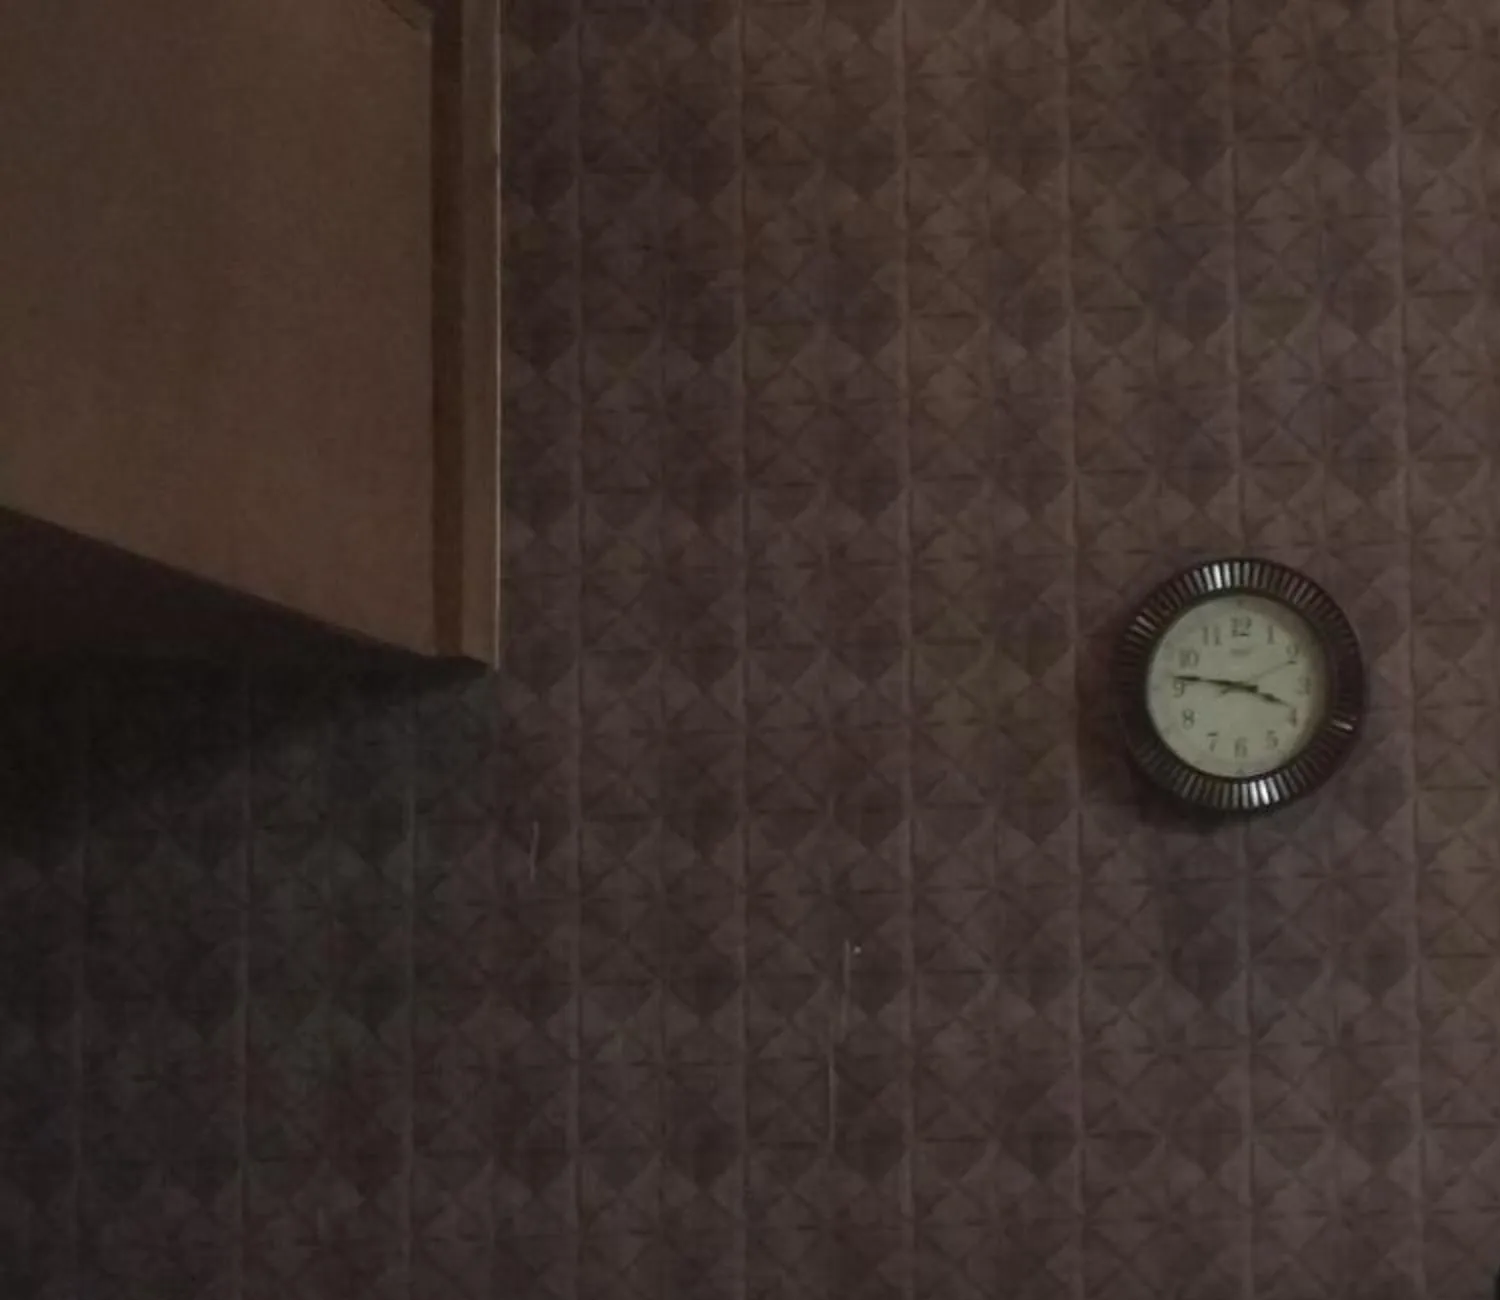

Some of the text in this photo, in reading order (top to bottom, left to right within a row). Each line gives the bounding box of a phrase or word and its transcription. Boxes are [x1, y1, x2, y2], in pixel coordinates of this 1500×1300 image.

[1203, 626, 1221, 645] 11
[1231, 617, 1252, 637] 12
[1266, 625, 1275, 644] 1
[1179, 650, 1199, 668] 10
[1173, 680, 1185, 697] 9
[1183, 708, 1195, 728] 8
[1207, 732, 1218, 750] 7
[1235, 737, 1247, 756] 6
[1266, 731, 1278, 748] 5
